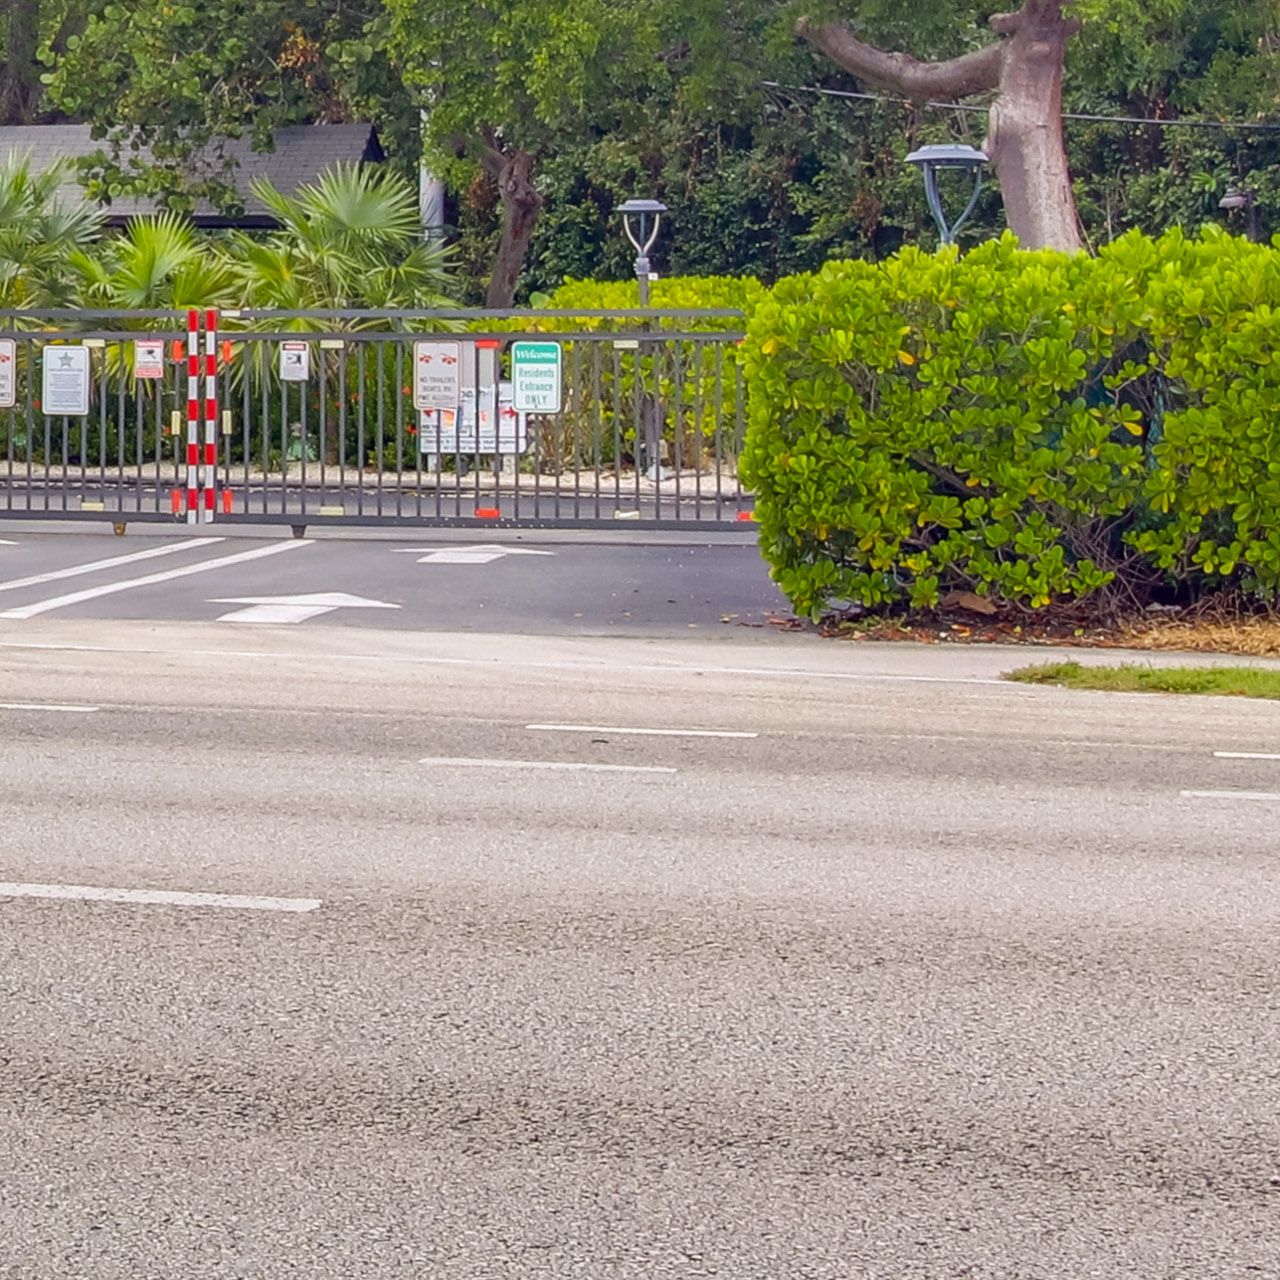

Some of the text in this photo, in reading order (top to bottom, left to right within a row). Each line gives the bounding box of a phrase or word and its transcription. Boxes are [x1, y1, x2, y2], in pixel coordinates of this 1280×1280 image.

[516, 349, 557, 359] Welcome
[519, 368, 555, 378] Residents
[520, 381, 553, 391] Entrance
[525, 395, 547, 405] ONLY
